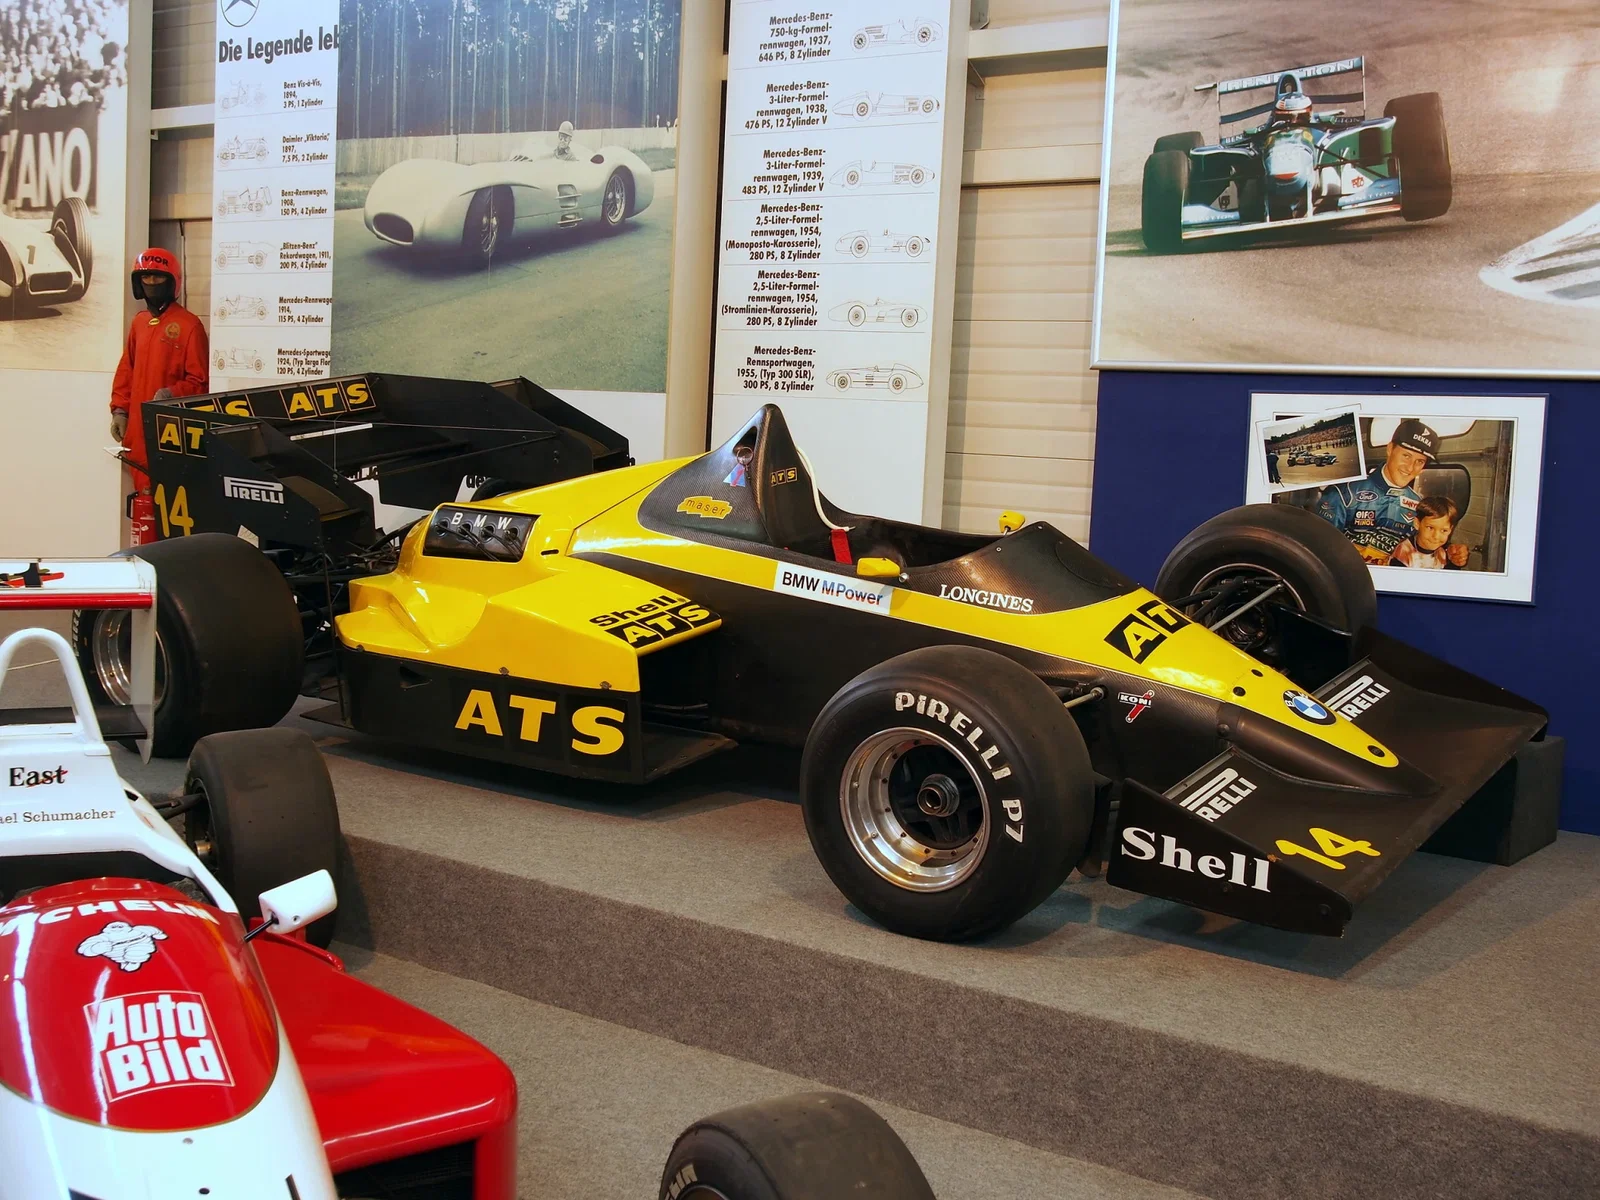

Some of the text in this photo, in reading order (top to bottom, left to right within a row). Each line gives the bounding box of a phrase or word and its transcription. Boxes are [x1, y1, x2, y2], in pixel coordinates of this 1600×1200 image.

[769, 12, 833, 25] Mercedes-Benz-
[770, 24, 832, 39] 750-kg-Formel-
[218, 38, 242, 63] Die
[247, 29, 313, 64] Legende
[759, 35, 831, 51] rennwagen, 1937,
[758, 48, 831, 62] 646 PS, 8 Zylinder
[283, 81, 296, 89] Benz
[766, 80, 829, 93] Mercedes-Benz-
[283, 90, 298, 99] 1894,
[769, 93, 829, 105] 3-Liter-Formel-
[288, 100, 296, 109] PS,
[301, 98, 323, 108] Zylinder
[756, 104, 828, 118] rennwagen, 1938,
[745, 116, 828, 130] 476 PS, 12 Zylinder V
[282, 135, 303, 143] Daimler
[282, 146, 296, 154] 1897,
[763, 148, 826, 159] Mercedes-Benz-
[282, 155, 291, 163] 7,5
[292, 154, 300, 162] PS,
[306, 153, 328, 163] Zylinder
[766, 160, 825, 171] 3-Liter-Formel-
[753, 171, 824, 185] rennwagen, 1939,
[281, 188, 328, 198] Benz-Rennwagen,
[742, 182, 824, 195] 483 PS, 12 Zylinder V
[281, 199, 295, 207] 1908,
[760, 203, 823, 214] Mercedes-Benz-
[281, 208, 290, 216] 150
[291, 208, 300, 216] PS,
[305, 207, 327, 216] Zylinder
[756, 216, 823, 226] 2,5-Liter-Formel-
[751, 227, 822, 239] rennwagen, 1954,
[725, 239, 821, 251] (Monoposto-Karosserie),
[280, 252, 318, 261] Rekordwagen,
[749, 251, 821, 262] 280 PS, 8 Zylinder
[280, 261, 327, 271] 200 PS, 4 Zylinder
[758, 270, 820, 280] Mercedes-Benz-
[753, 282, 819, 292] 2,5-Liter-Formel-
[748, 294, 818, 305] rennwagen, 1954,
[278, 306, 291, 315] 1914,
[722, 304, 818, 316] (Stromlinien-Karosserie),
[288, 316, 296, 324] PS,
[302, 315, 324, 324] Zylinder
[746, 317, 817, 328] 280 PS, 8 Zylinder
[754, 346, 816, 355] Mercedes-Benz-
[277, 358, 290, 366] 1924,
[292, 358, 303, 367] (Typ
[746, 358, 815, 369] Rennsportwagen,
[287, 368, 295, 376] PS,
[302, 367, 323, 376] Zylinder
[737, 369, 814, 380] 1955, (Typ 300 SLR),
[743, 381, 814, 391] 300 PS, 8 Zylinder
[290, 384, 368, 414] ATS
[1413, 434, 1432, 448] DEKRA
[770, 469, 796, 484] ATS
[224, 476, 284, 504] PIRELLI
[1359, 492, 1373, 500] Ford
[154, 483, 194, 537] 14
[686, 498, 726, 515] maser
[782, 571, 820, 591] BMW
[939, 584, 1034, 612] LONGINES
[589, 595, 677, 627] Shell
[622, 604, 710, 644] ATS
[1120, 693, 1151, 707] KONI
[454, 689, 626, 756] ATS
[9, 765, 66, 787] East
[1180, 768, 1257, 822] PRELLI
[23, 809, 116, 823] Schumacher
[1002, 799, 1024, 843] P7
[1275, 828, 1381, 870] 14
[1121, 827, 1271, 892] Shell
[94, 994, 206, 1050] Auto
[106, 1040, 225, 1094] Bild
